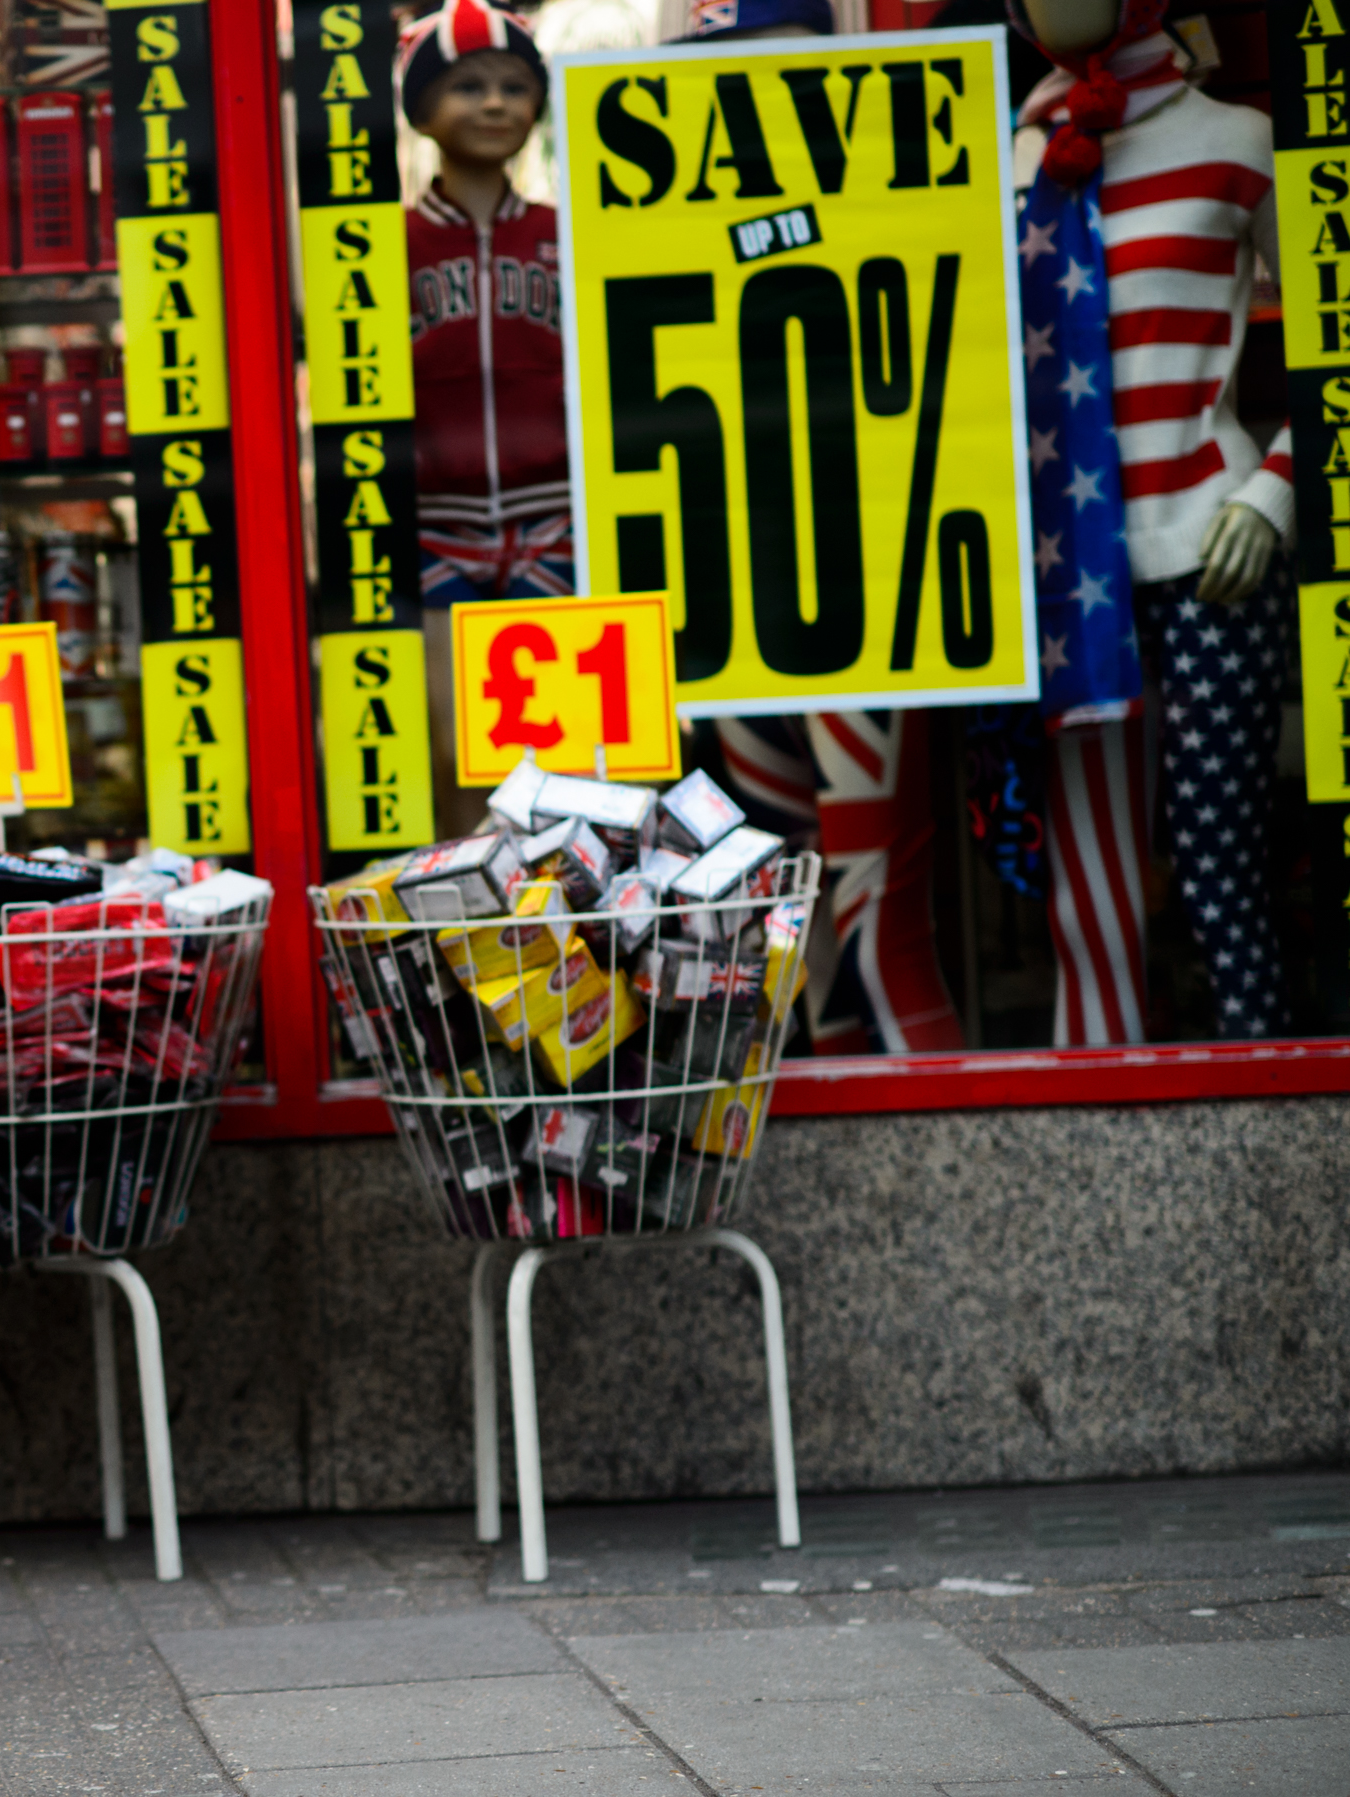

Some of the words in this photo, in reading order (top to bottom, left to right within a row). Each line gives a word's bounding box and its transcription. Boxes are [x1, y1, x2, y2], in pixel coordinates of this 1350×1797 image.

[137, 15, 191, 207] SALE
[320, 3, 373, 197] SALE
[596, 57, 971, 211] SAVE
[153, 229, 197, 419] SALE
[334, 219, 380, 409] SALE
[737, 219, 773, 258] UP
[773, 209, 811, 248] TO
[1309, 160, 1350, 354] SALE
[162, 440, 214, 633] SALE
[342, 430, 395, 624] SALE
[604, 253, 994, 683] 50%
[174, 654, 222, 843] SALE
[354, 646, 400, 835] SALE
[483, 622, 631, 750] £1
